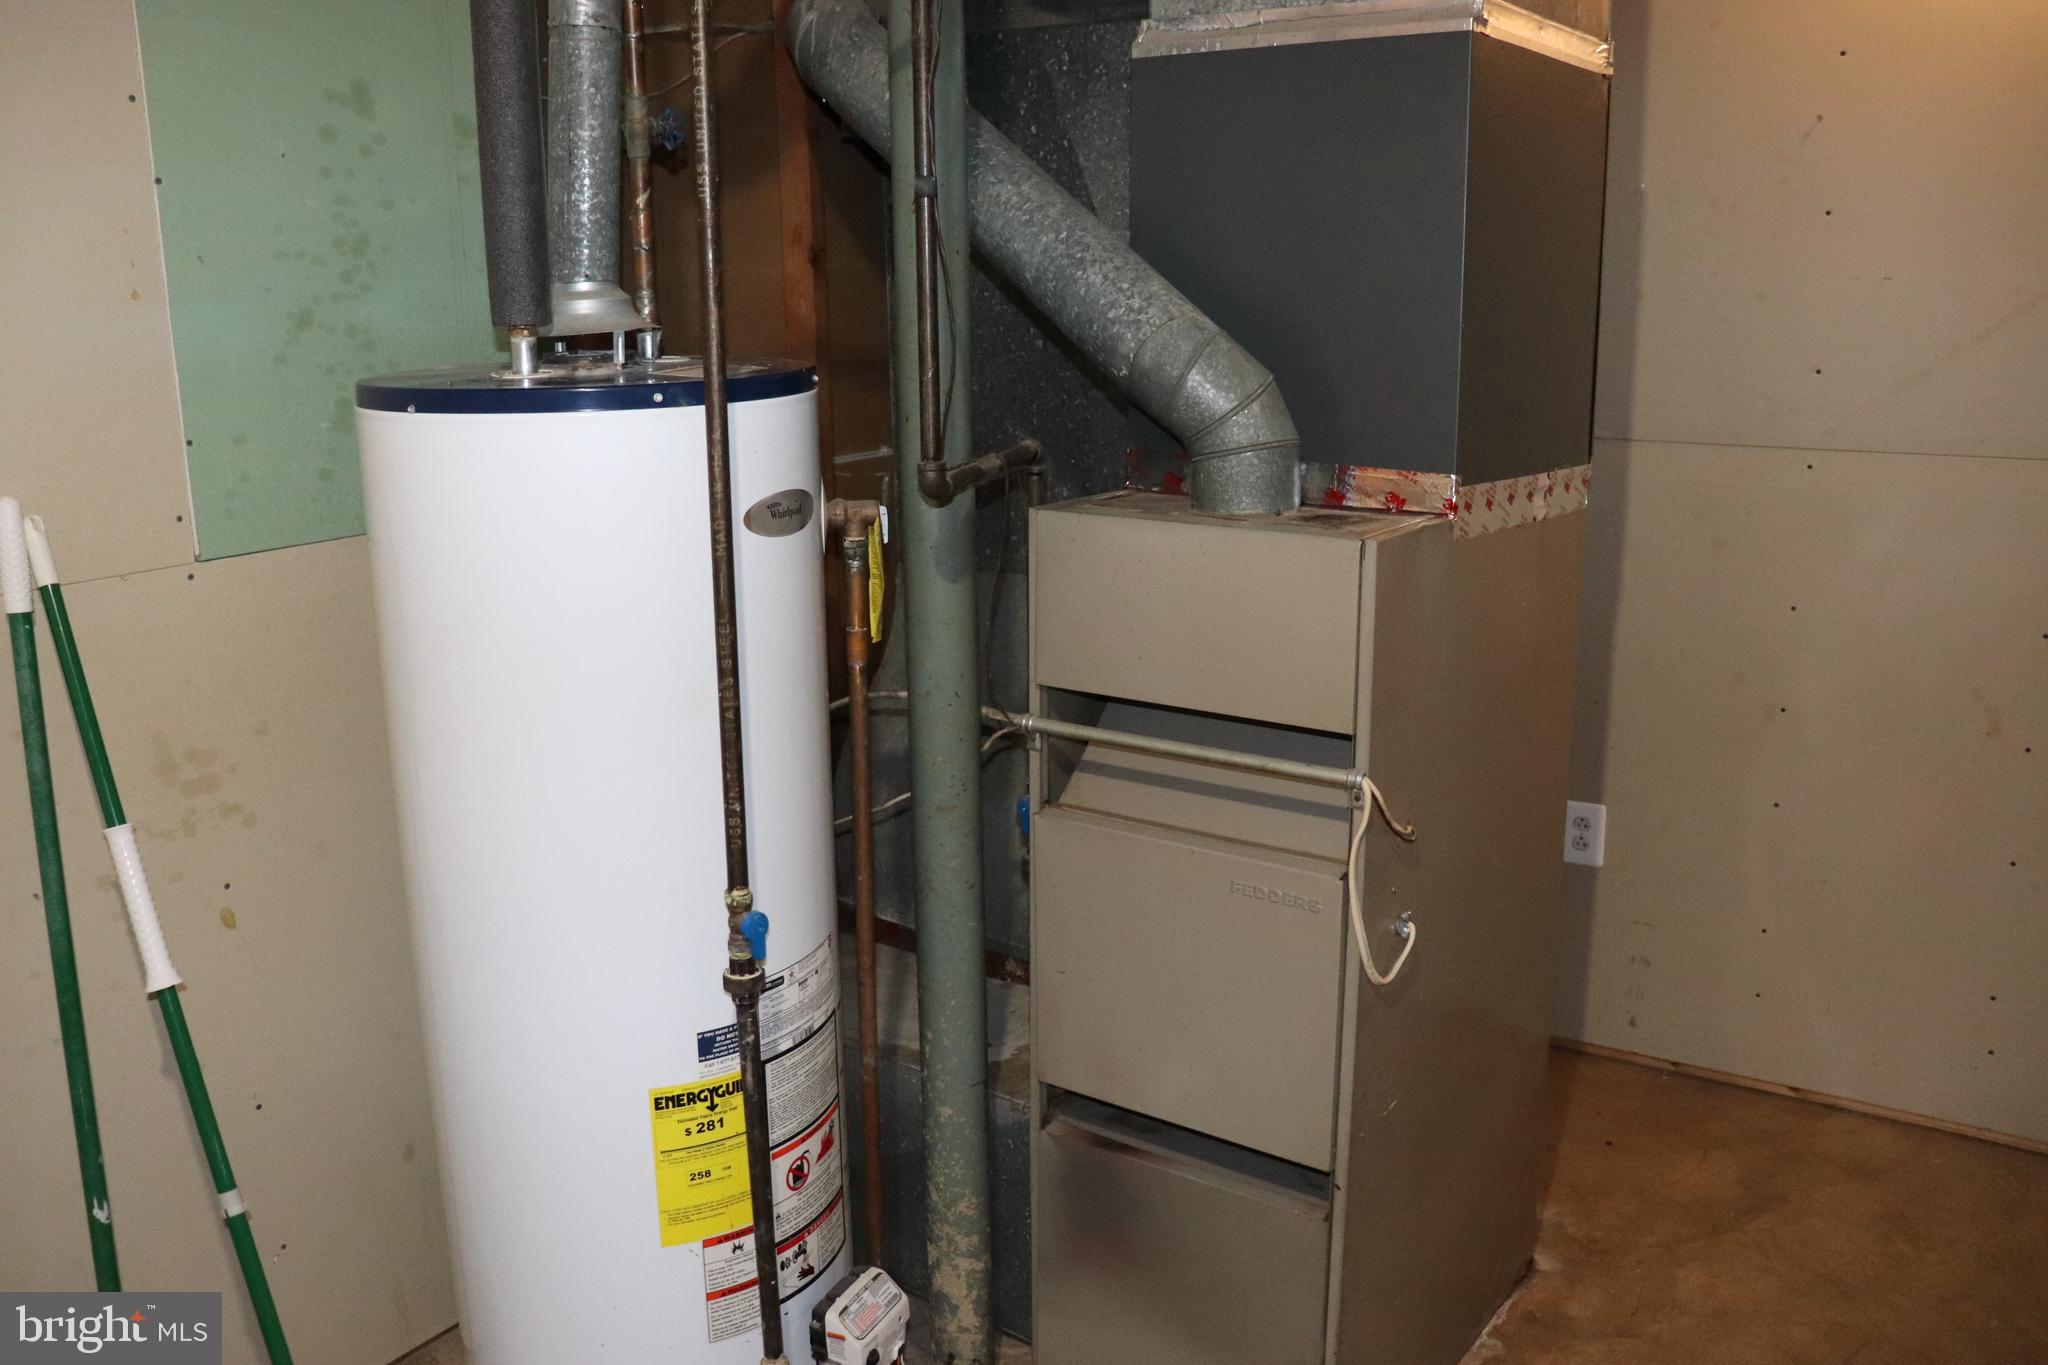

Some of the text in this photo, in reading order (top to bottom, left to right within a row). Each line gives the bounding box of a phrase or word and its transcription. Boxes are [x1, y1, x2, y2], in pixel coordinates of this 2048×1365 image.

[769, 503, 802, 520] Whirlpool
[1230, 880, 1323, 913] FEDDERS
[654, 1080, 743, 1112] ENERGYGUI
[685, 1117, 724, 1137] $ 281
[689, 1169, 712, 1182] 258
